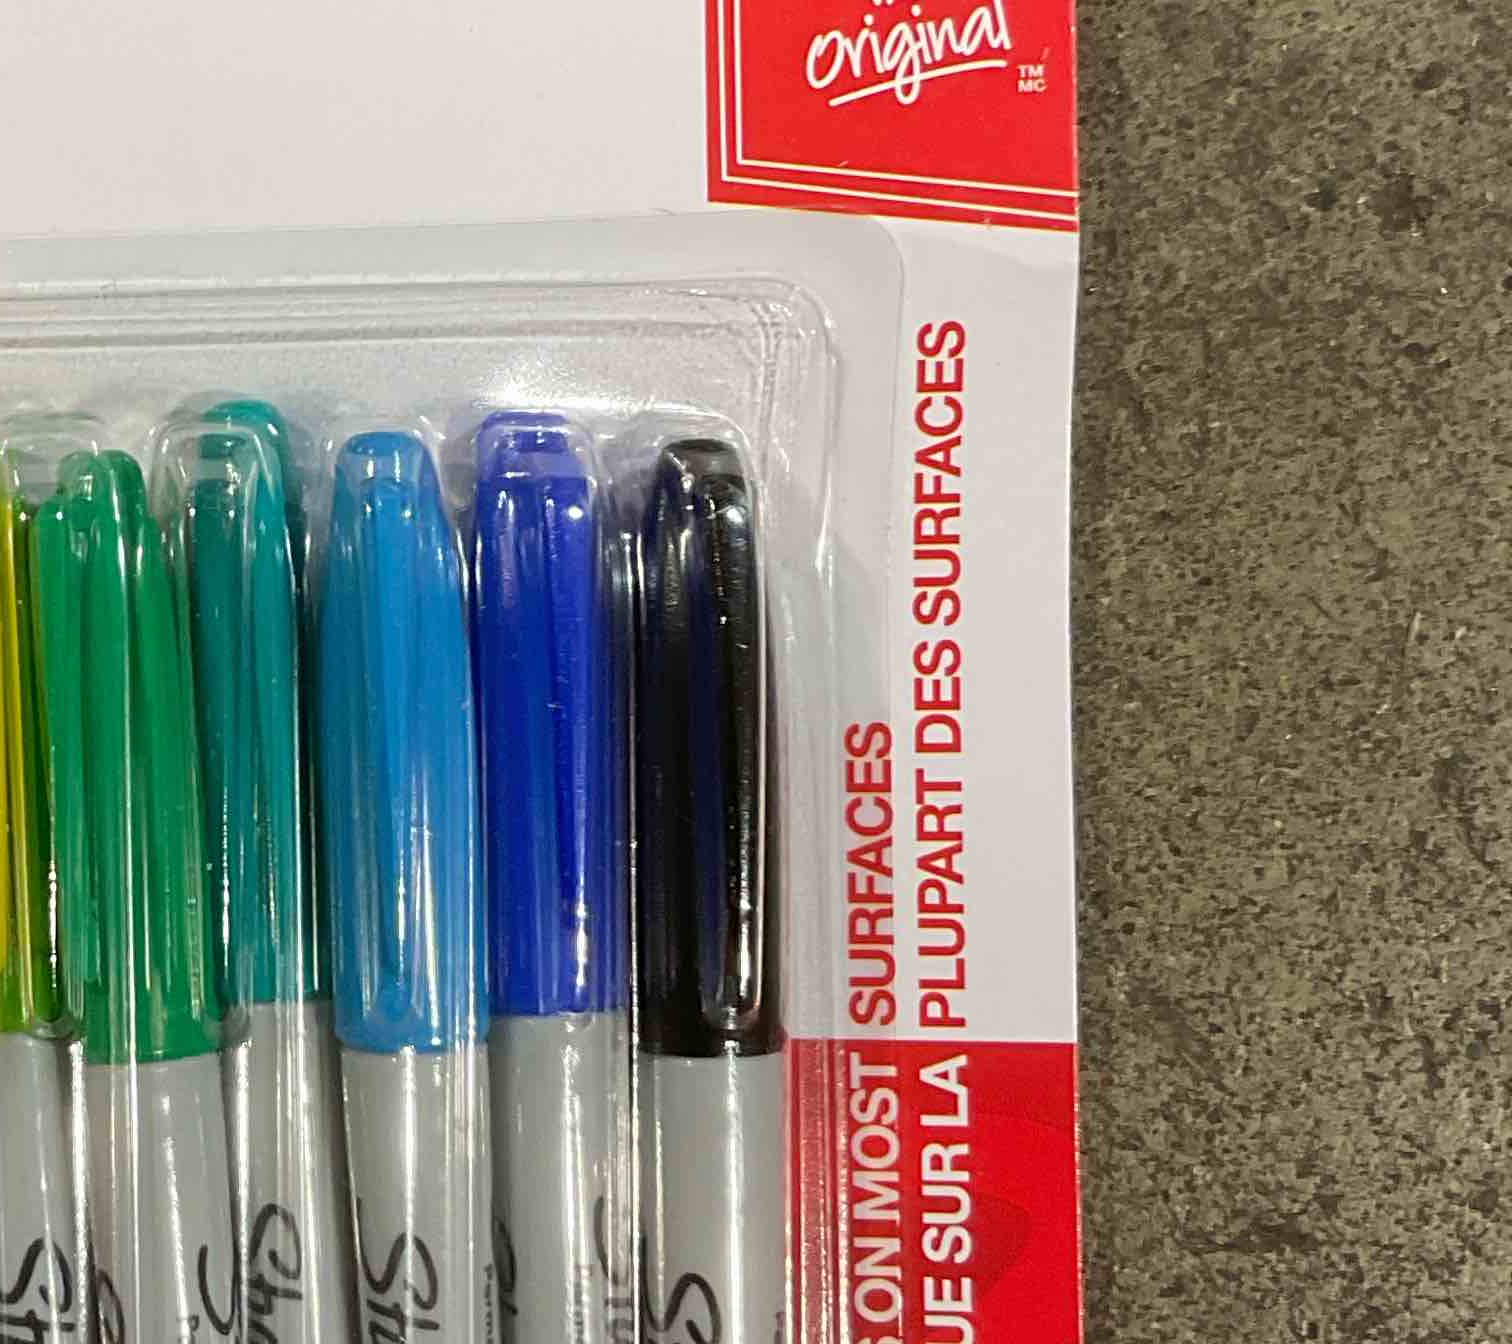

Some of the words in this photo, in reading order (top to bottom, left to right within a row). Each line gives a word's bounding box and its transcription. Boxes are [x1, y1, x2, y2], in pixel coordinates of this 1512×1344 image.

[1017, 64, 1045, 79] TM
[1017, 79, 1047, 94] MC
[912, 320, 967, 626] SURFACES
[913, 639, 964, 754] DES
[844, 721, 897, 1026] SURFACES
[914, 768, 967, 1029] PLUPART
[849, 1052, 900, 1231] MOST
[919, 1054, 970, 1127] LA
[921, 1143, 972, 1265] SUR
[854, 1236, 903, 1324] ON
